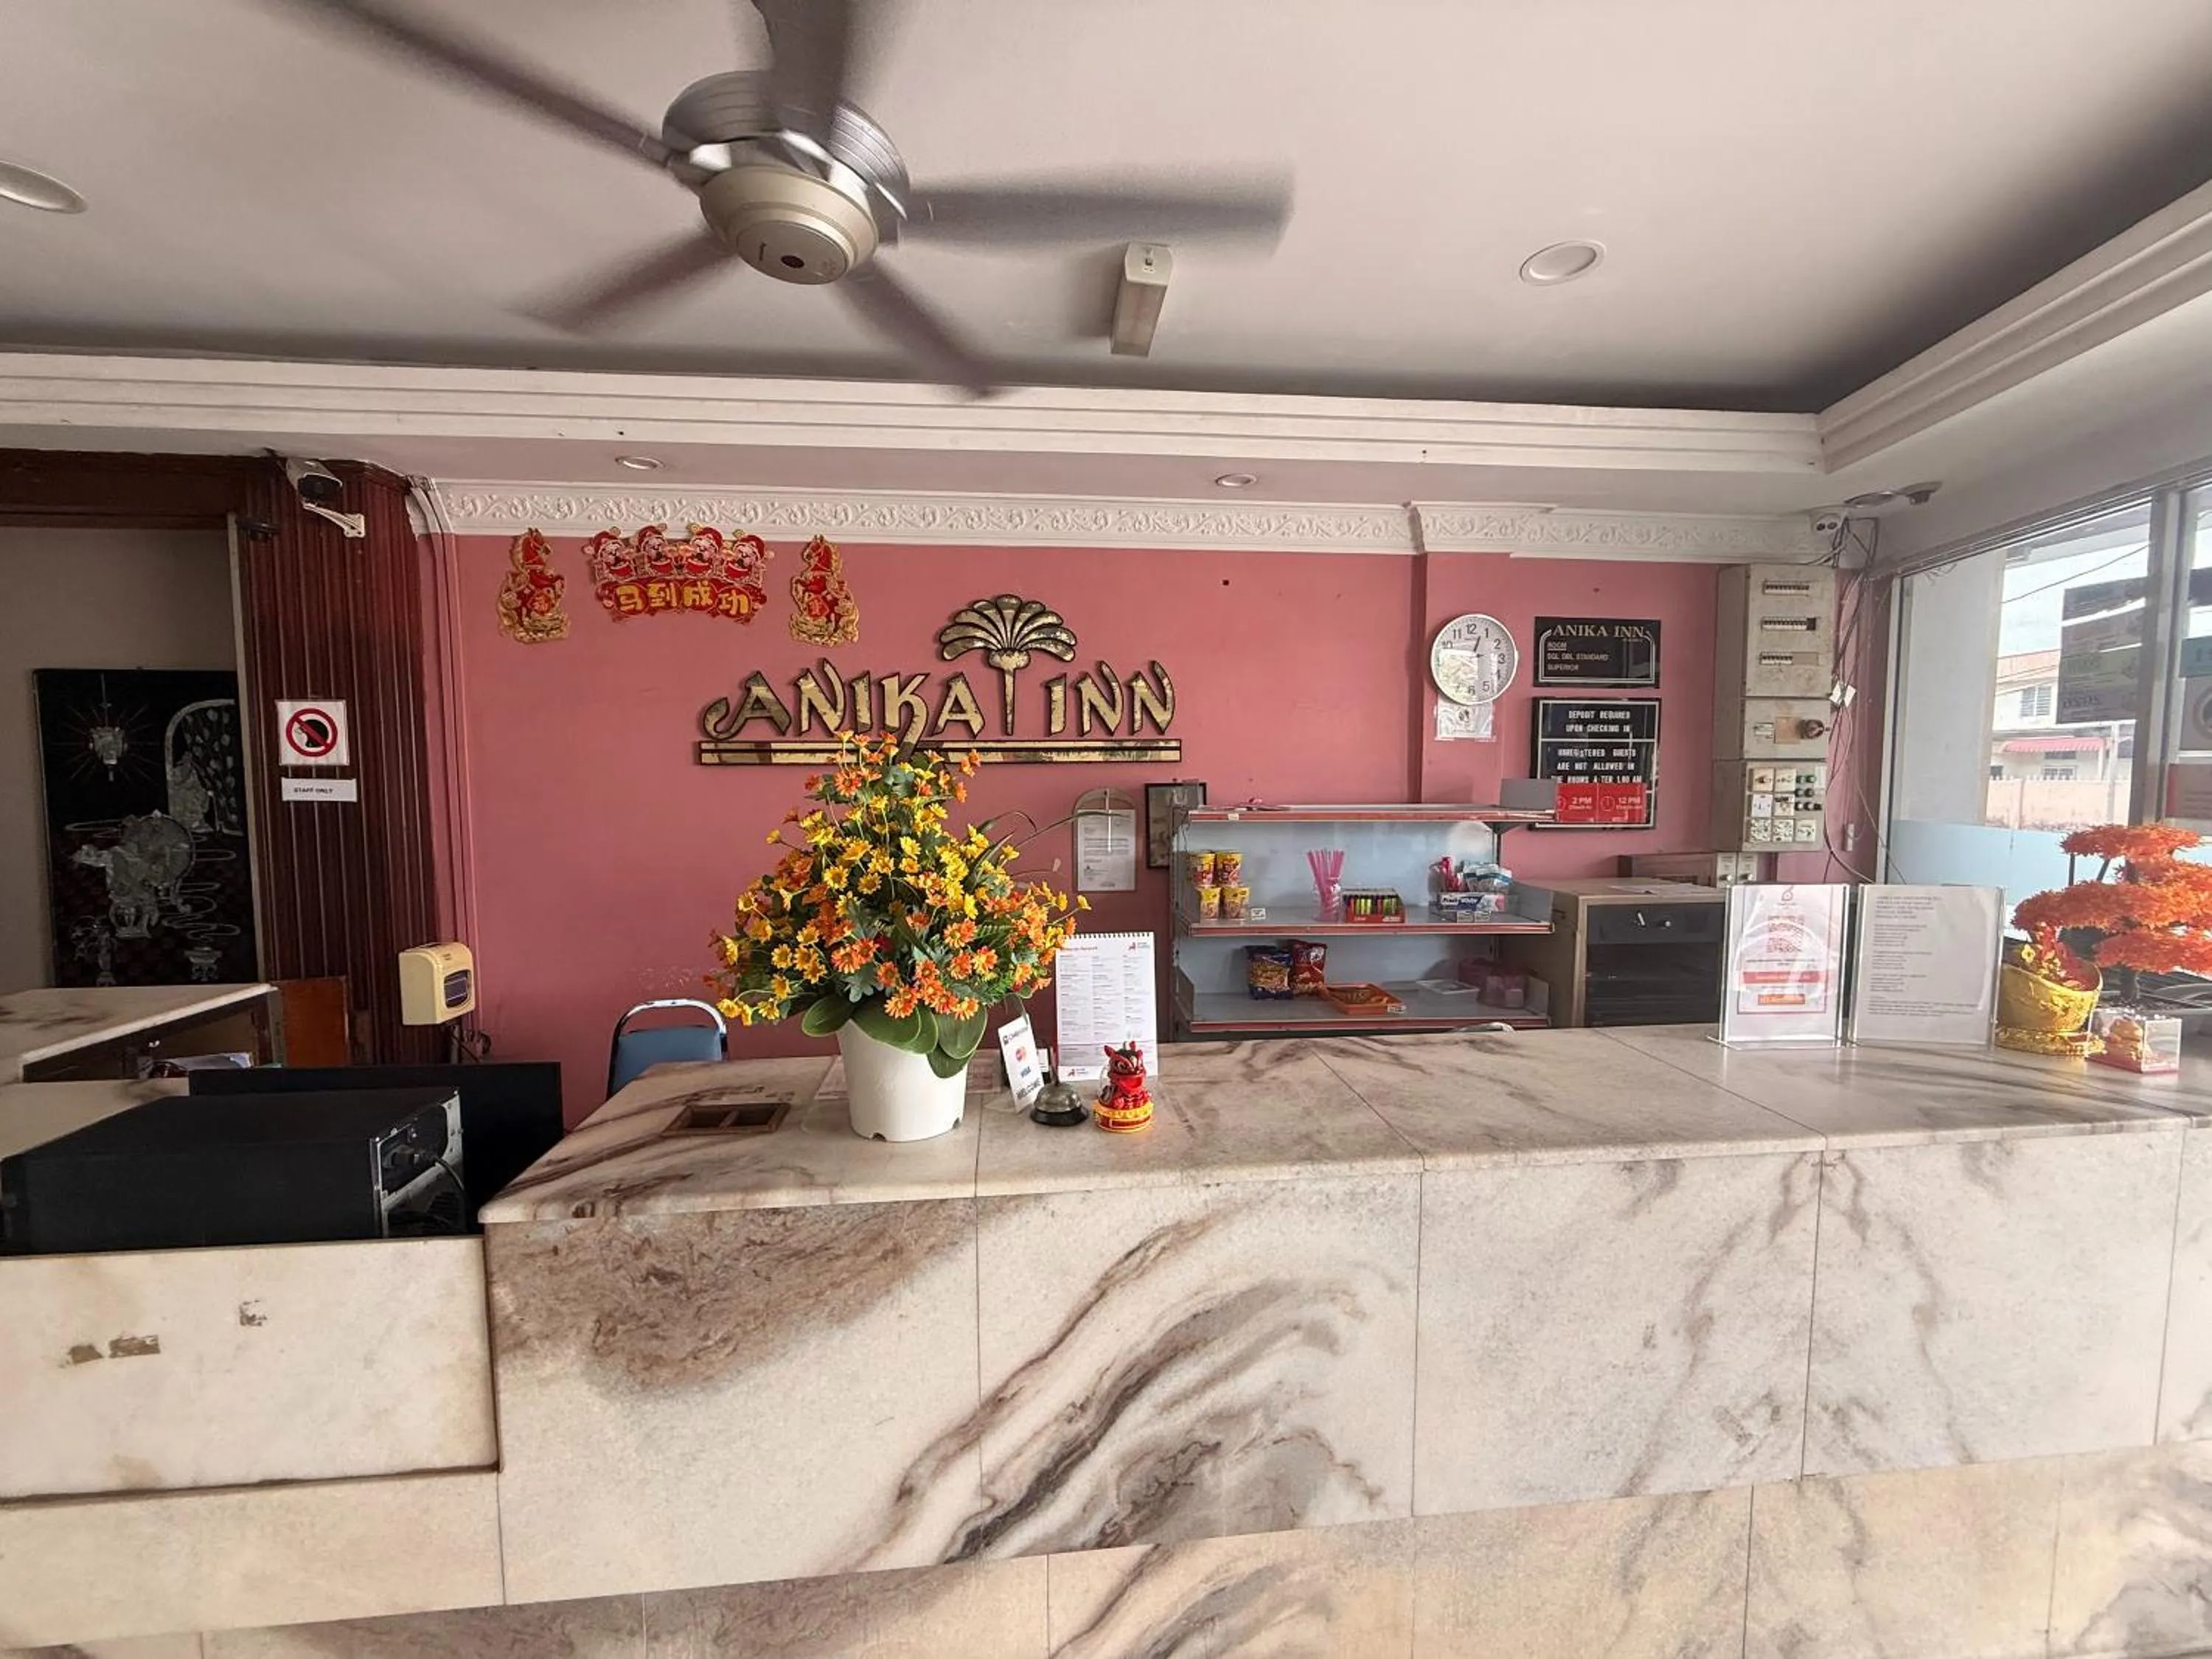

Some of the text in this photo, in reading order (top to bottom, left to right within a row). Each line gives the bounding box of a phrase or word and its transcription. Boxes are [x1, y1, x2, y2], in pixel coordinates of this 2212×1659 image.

[616, 580, 750, 615] 马到成功
[1453, 628, 1461, 639] 11
[1466, 623, 1477, 635] 12
[1484, 627, 1489, 639] 1
[1552, 625, 1644, 638] ANIKA INN
[1494, 639, 1501, 650] 2
[1498, 653, 1506, 664] 3
[1482, 681, 1490, 692] 5
[703, 657, 1175, 761] ANIKA INN
[1568, 710, 1631, 720] DEPOSIT REQUIRED
[1565, 724, 1630, 732] UPON CHECKING IN
[1557, 762, 1635, 771] ARE NOT ALLOWED IN
